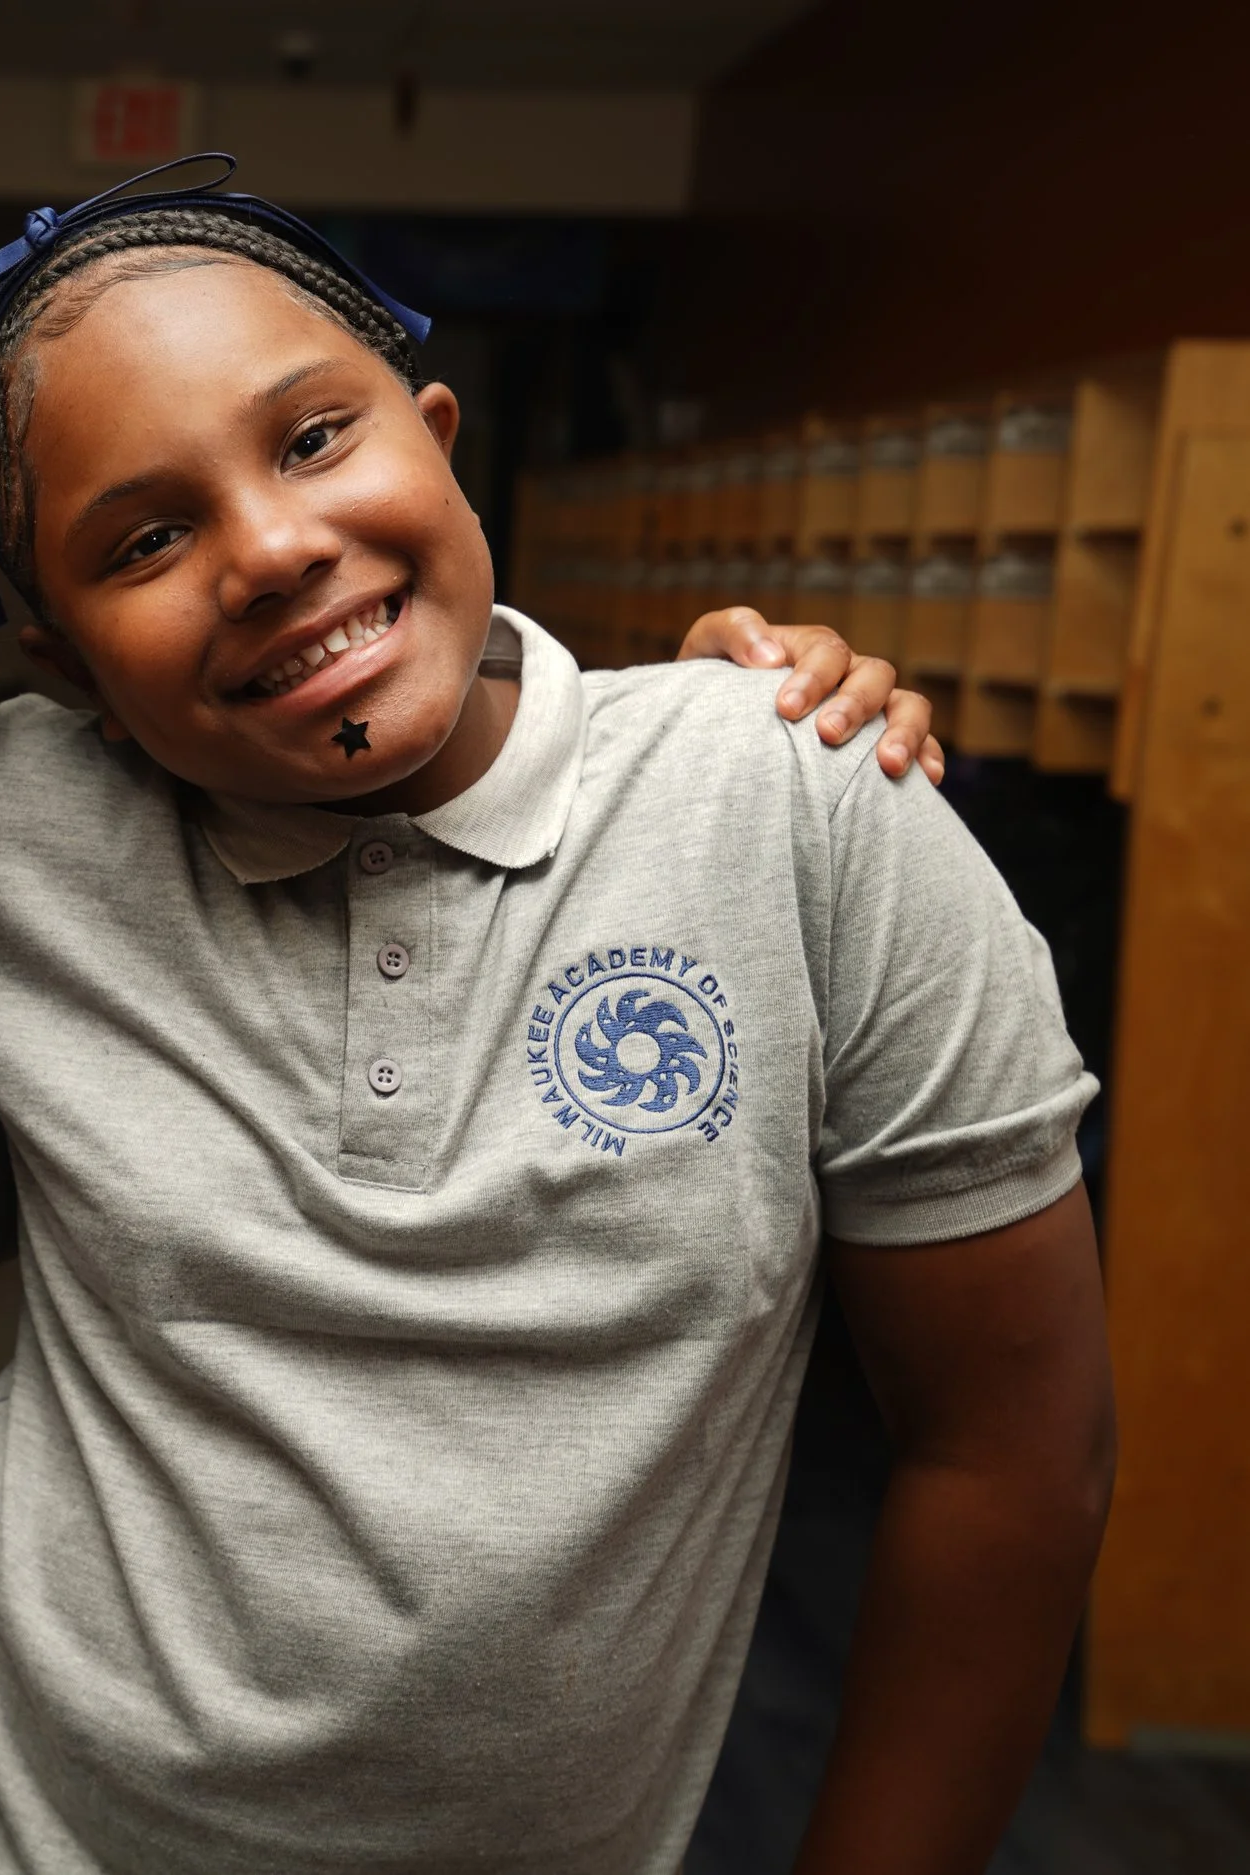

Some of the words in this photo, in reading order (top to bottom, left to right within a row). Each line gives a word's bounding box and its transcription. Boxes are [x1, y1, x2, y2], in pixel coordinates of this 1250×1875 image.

[548, 946, 697, 1005] ACADEMY
[698, 974, 728, 1009] OF
[527, 1005, 626, 1157] MILWAUKEE
[697, 1019, 740, 1142] SCIENCE
